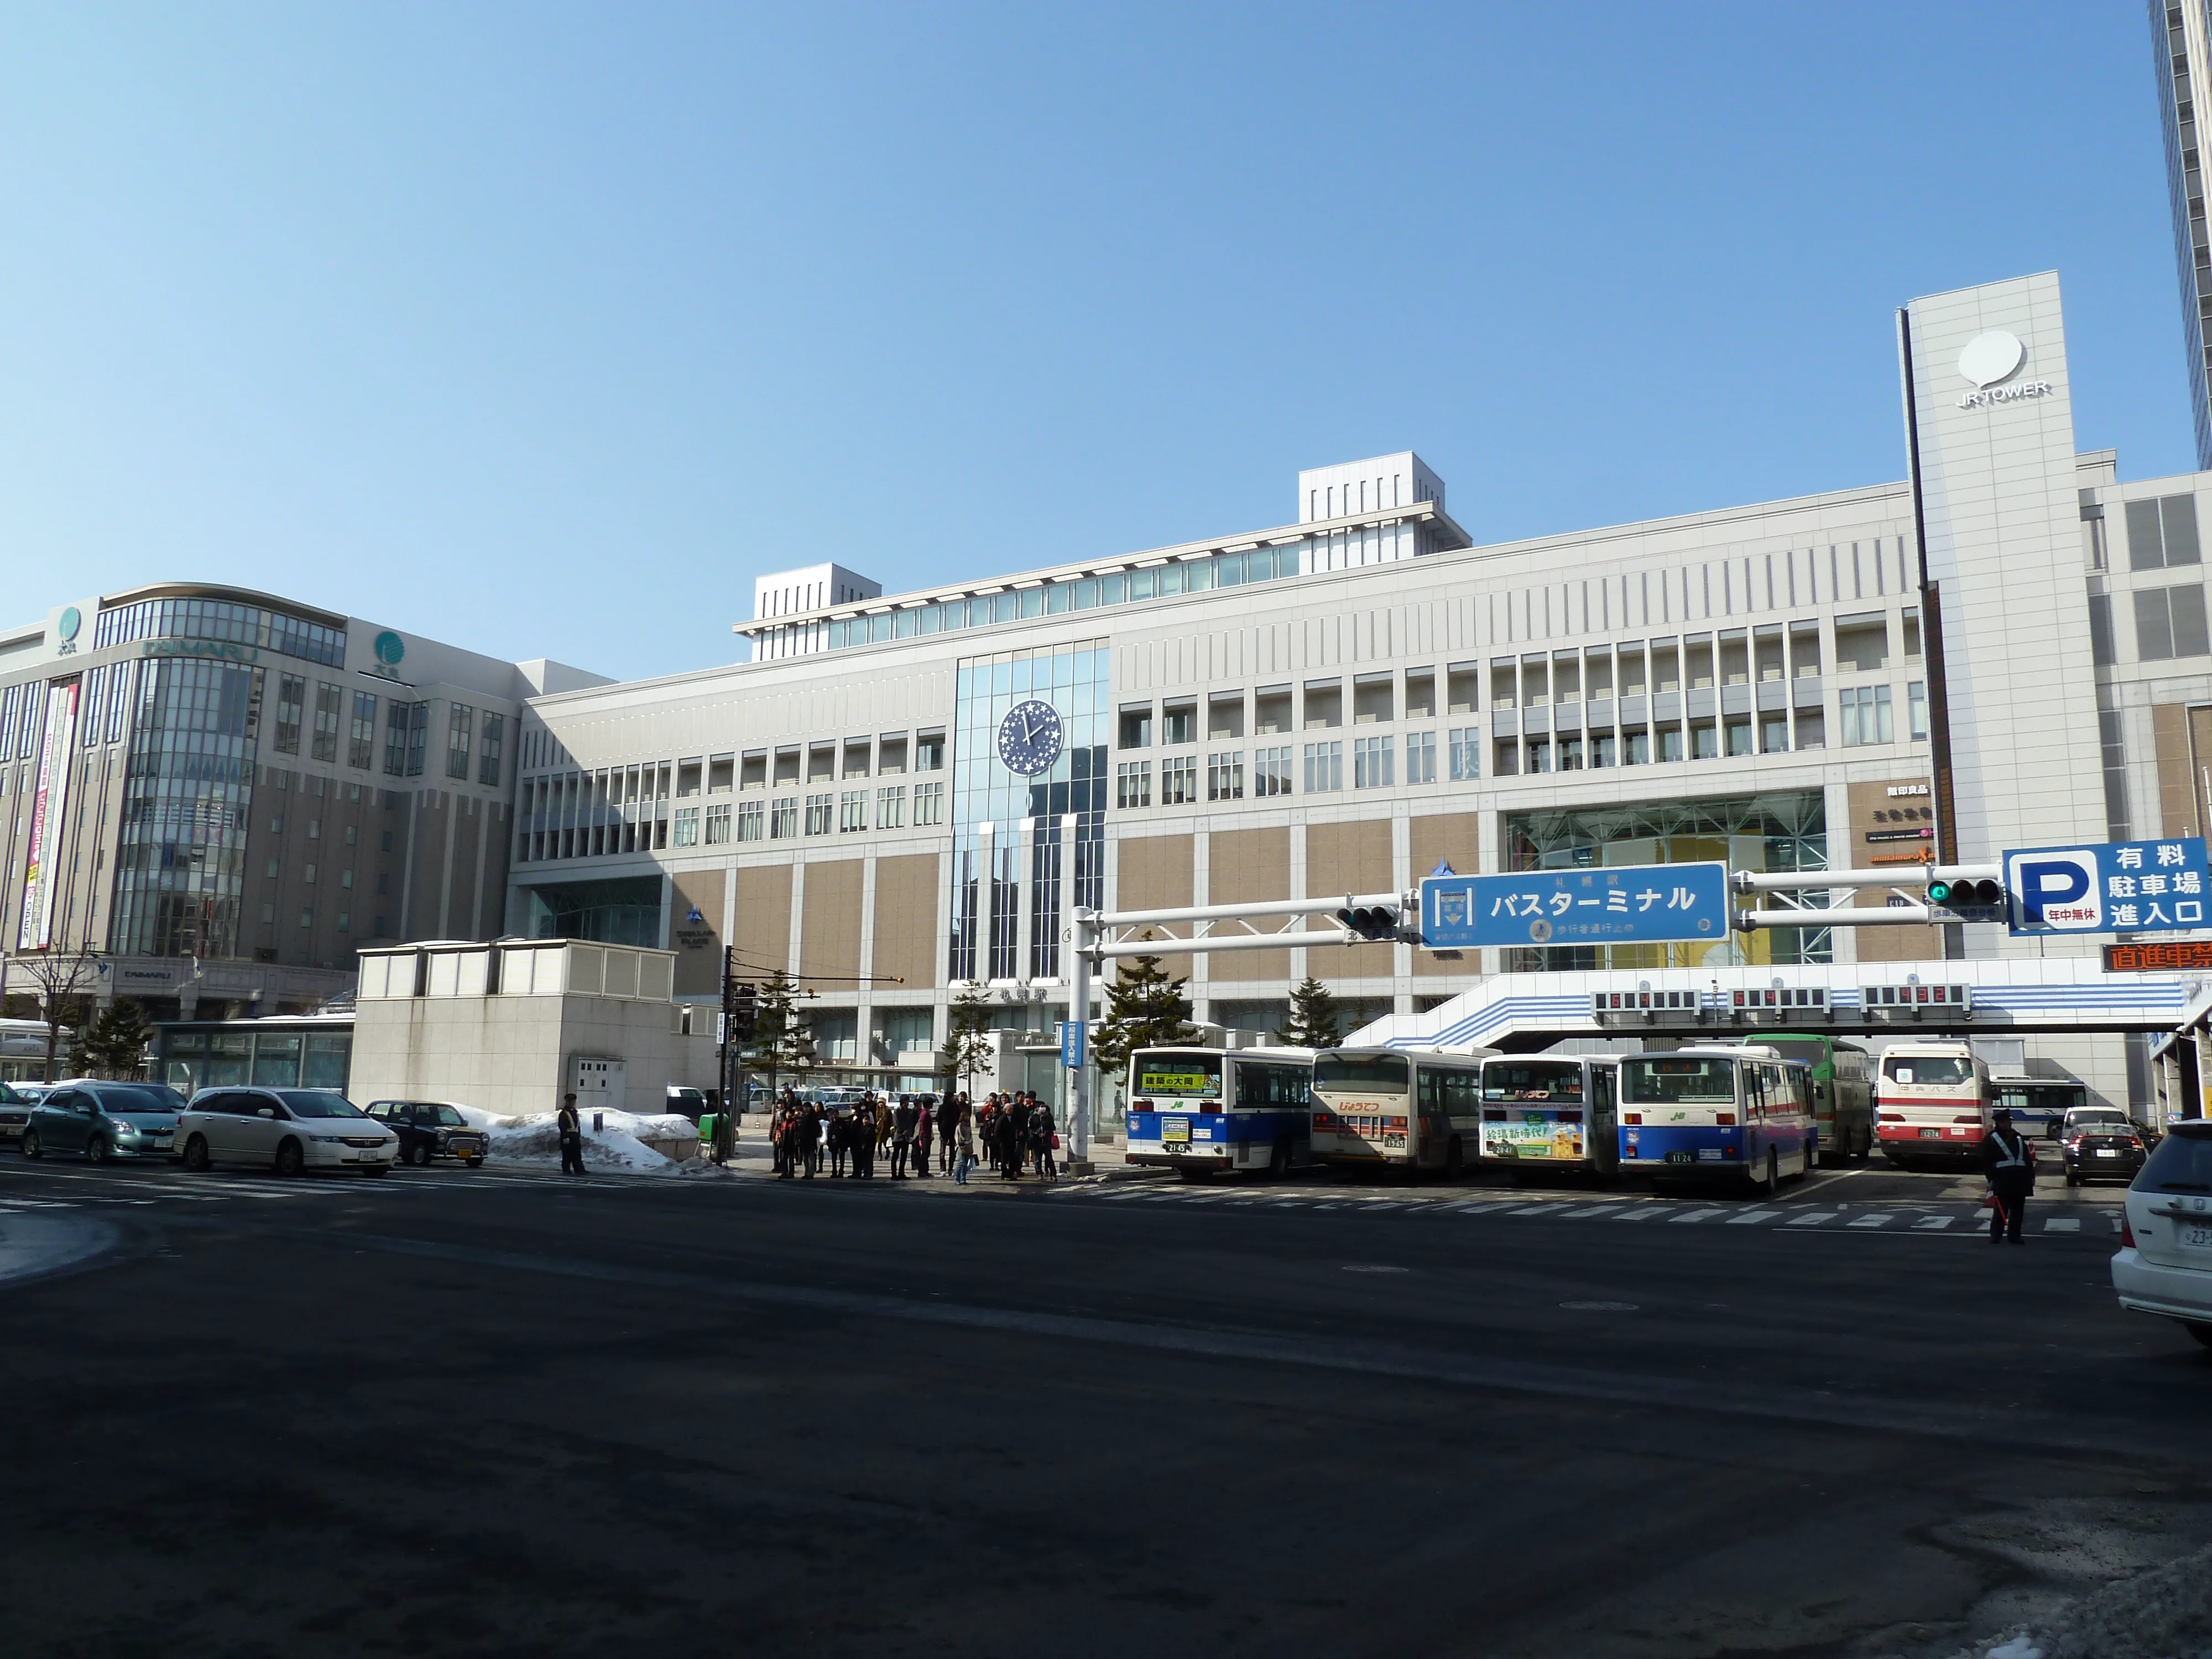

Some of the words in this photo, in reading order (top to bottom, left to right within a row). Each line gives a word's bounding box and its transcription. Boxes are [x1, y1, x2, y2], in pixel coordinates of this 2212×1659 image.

[1955, 392, 1979, 407] JR
[1981, 380, 2048, 401] TOWER
[142, 639, 258, 662] DAIMARU
[1887, 785, 1928, 796] 無印良品
[2116, 844, 2185, 869] 有料
[2020, 860, 2089, 922] P
[2109, 872, 2201, 898] 駐車場
[1491, 886, 1696, 917] バスターミナル
[2110, 901, 2203, 927] 進入口
[23, 901, 32, 940] OPEN
[2048, 908, 2096, 921] 年中無休
[2110, 942, 2212, 971] 直進車禁
[999, 986, 1048, 1003] 札幌駅
[1145, 1076, 1193, 1086] 建築の大岡
[1339, 1101, 1380, 1112] じょうてつ
